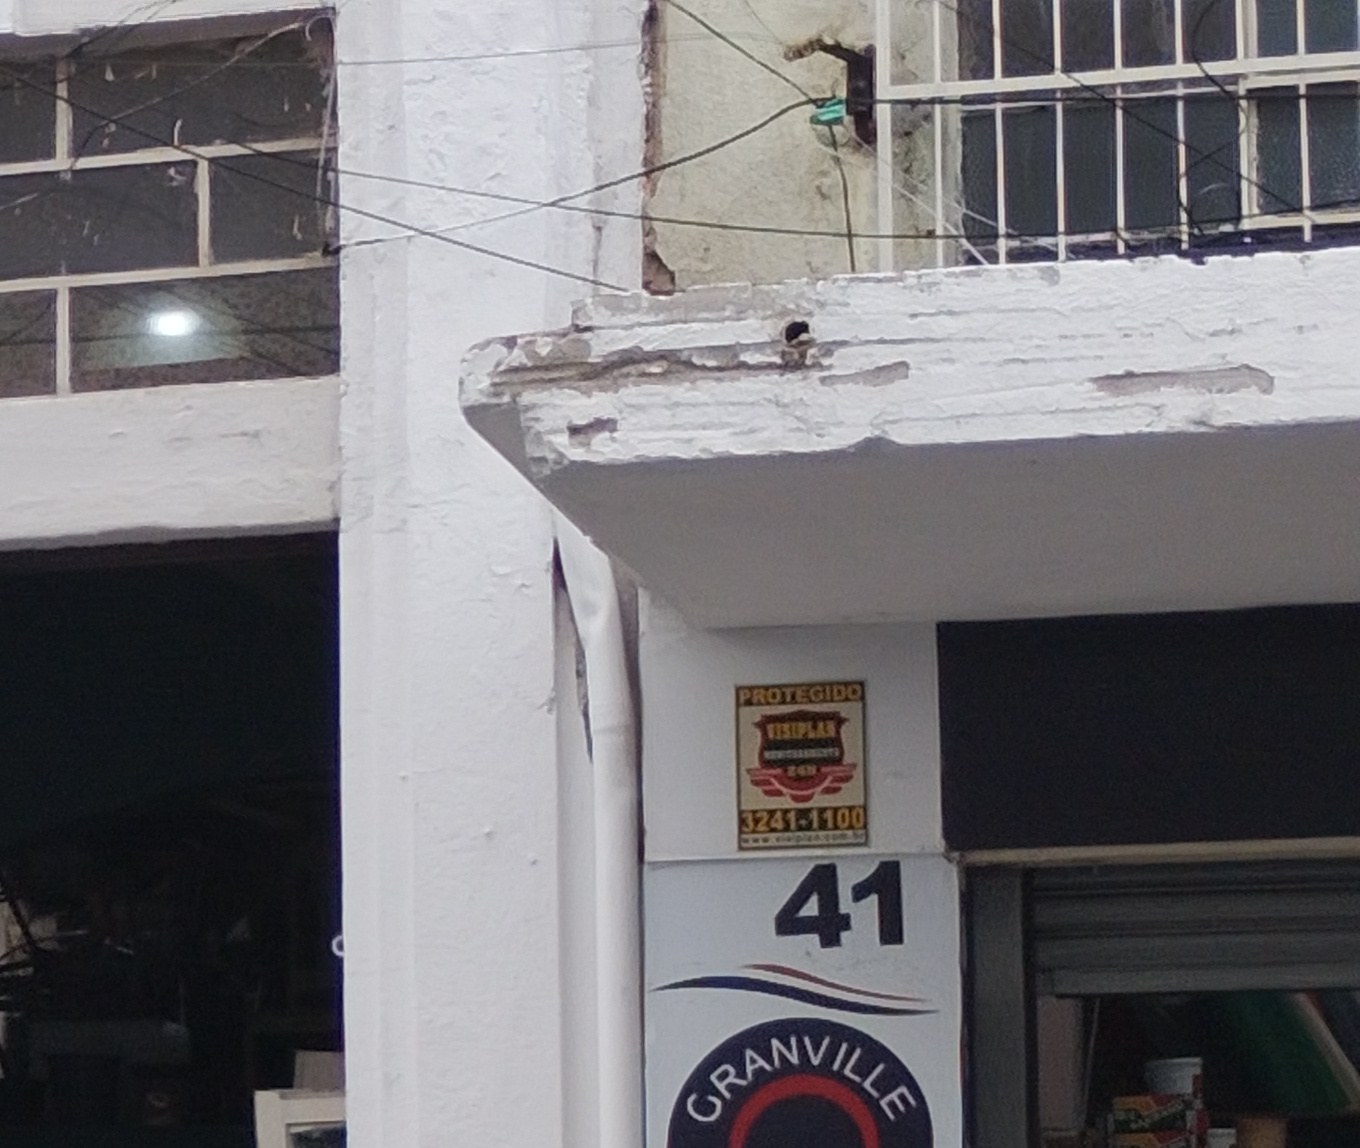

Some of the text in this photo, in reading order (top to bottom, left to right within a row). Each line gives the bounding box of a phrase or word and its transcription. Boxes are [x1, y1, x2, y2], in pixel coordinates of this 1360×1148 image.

[739, 684, 862, 704] PROTEGIDO
[741, 808, 865, 833] 3241-1100
[774, 860, 905, 948] 41
[686, 1035, 917, 1122] GRANVILLE
